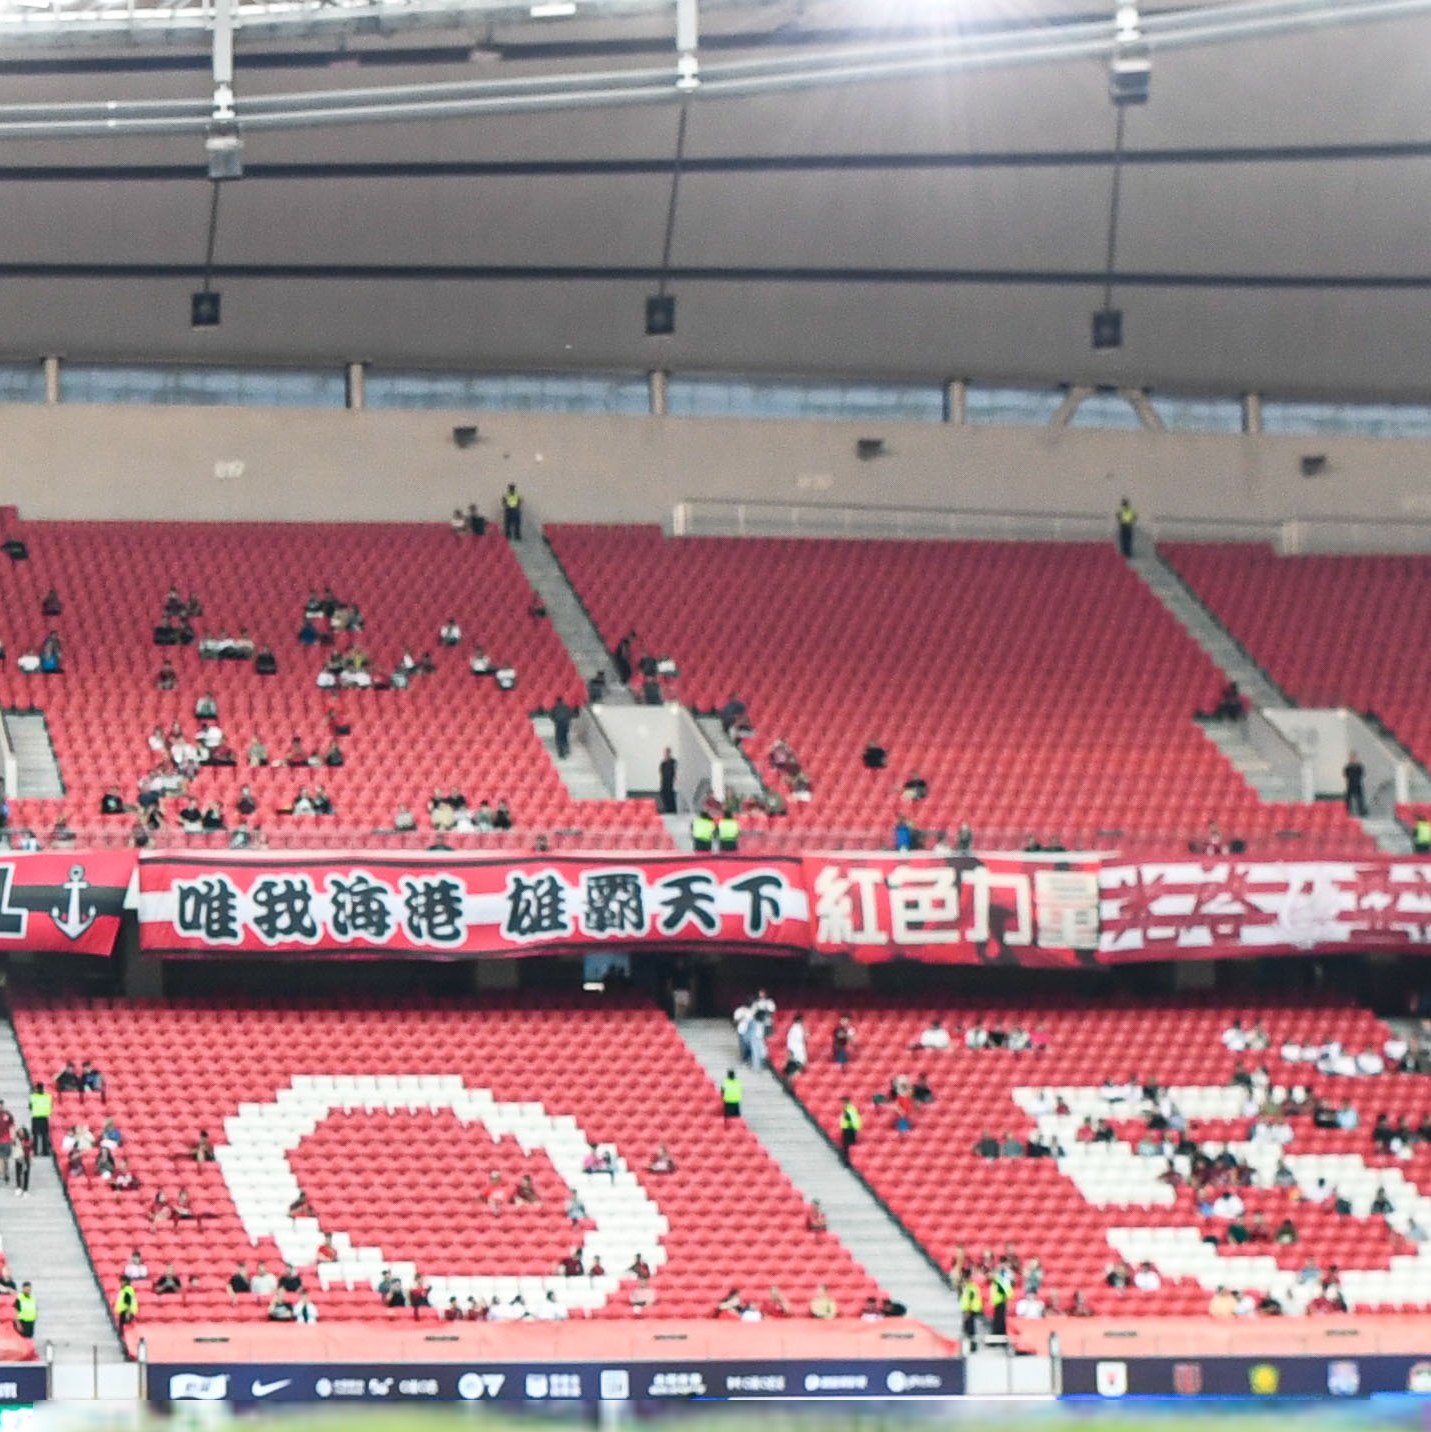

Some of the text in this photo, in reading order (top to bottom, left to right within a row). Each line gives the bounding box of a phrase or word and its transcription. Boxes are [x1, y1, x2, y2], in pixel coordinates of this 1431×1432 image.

[175, 871, 785, 942] 唯我海港 雄霸天下
